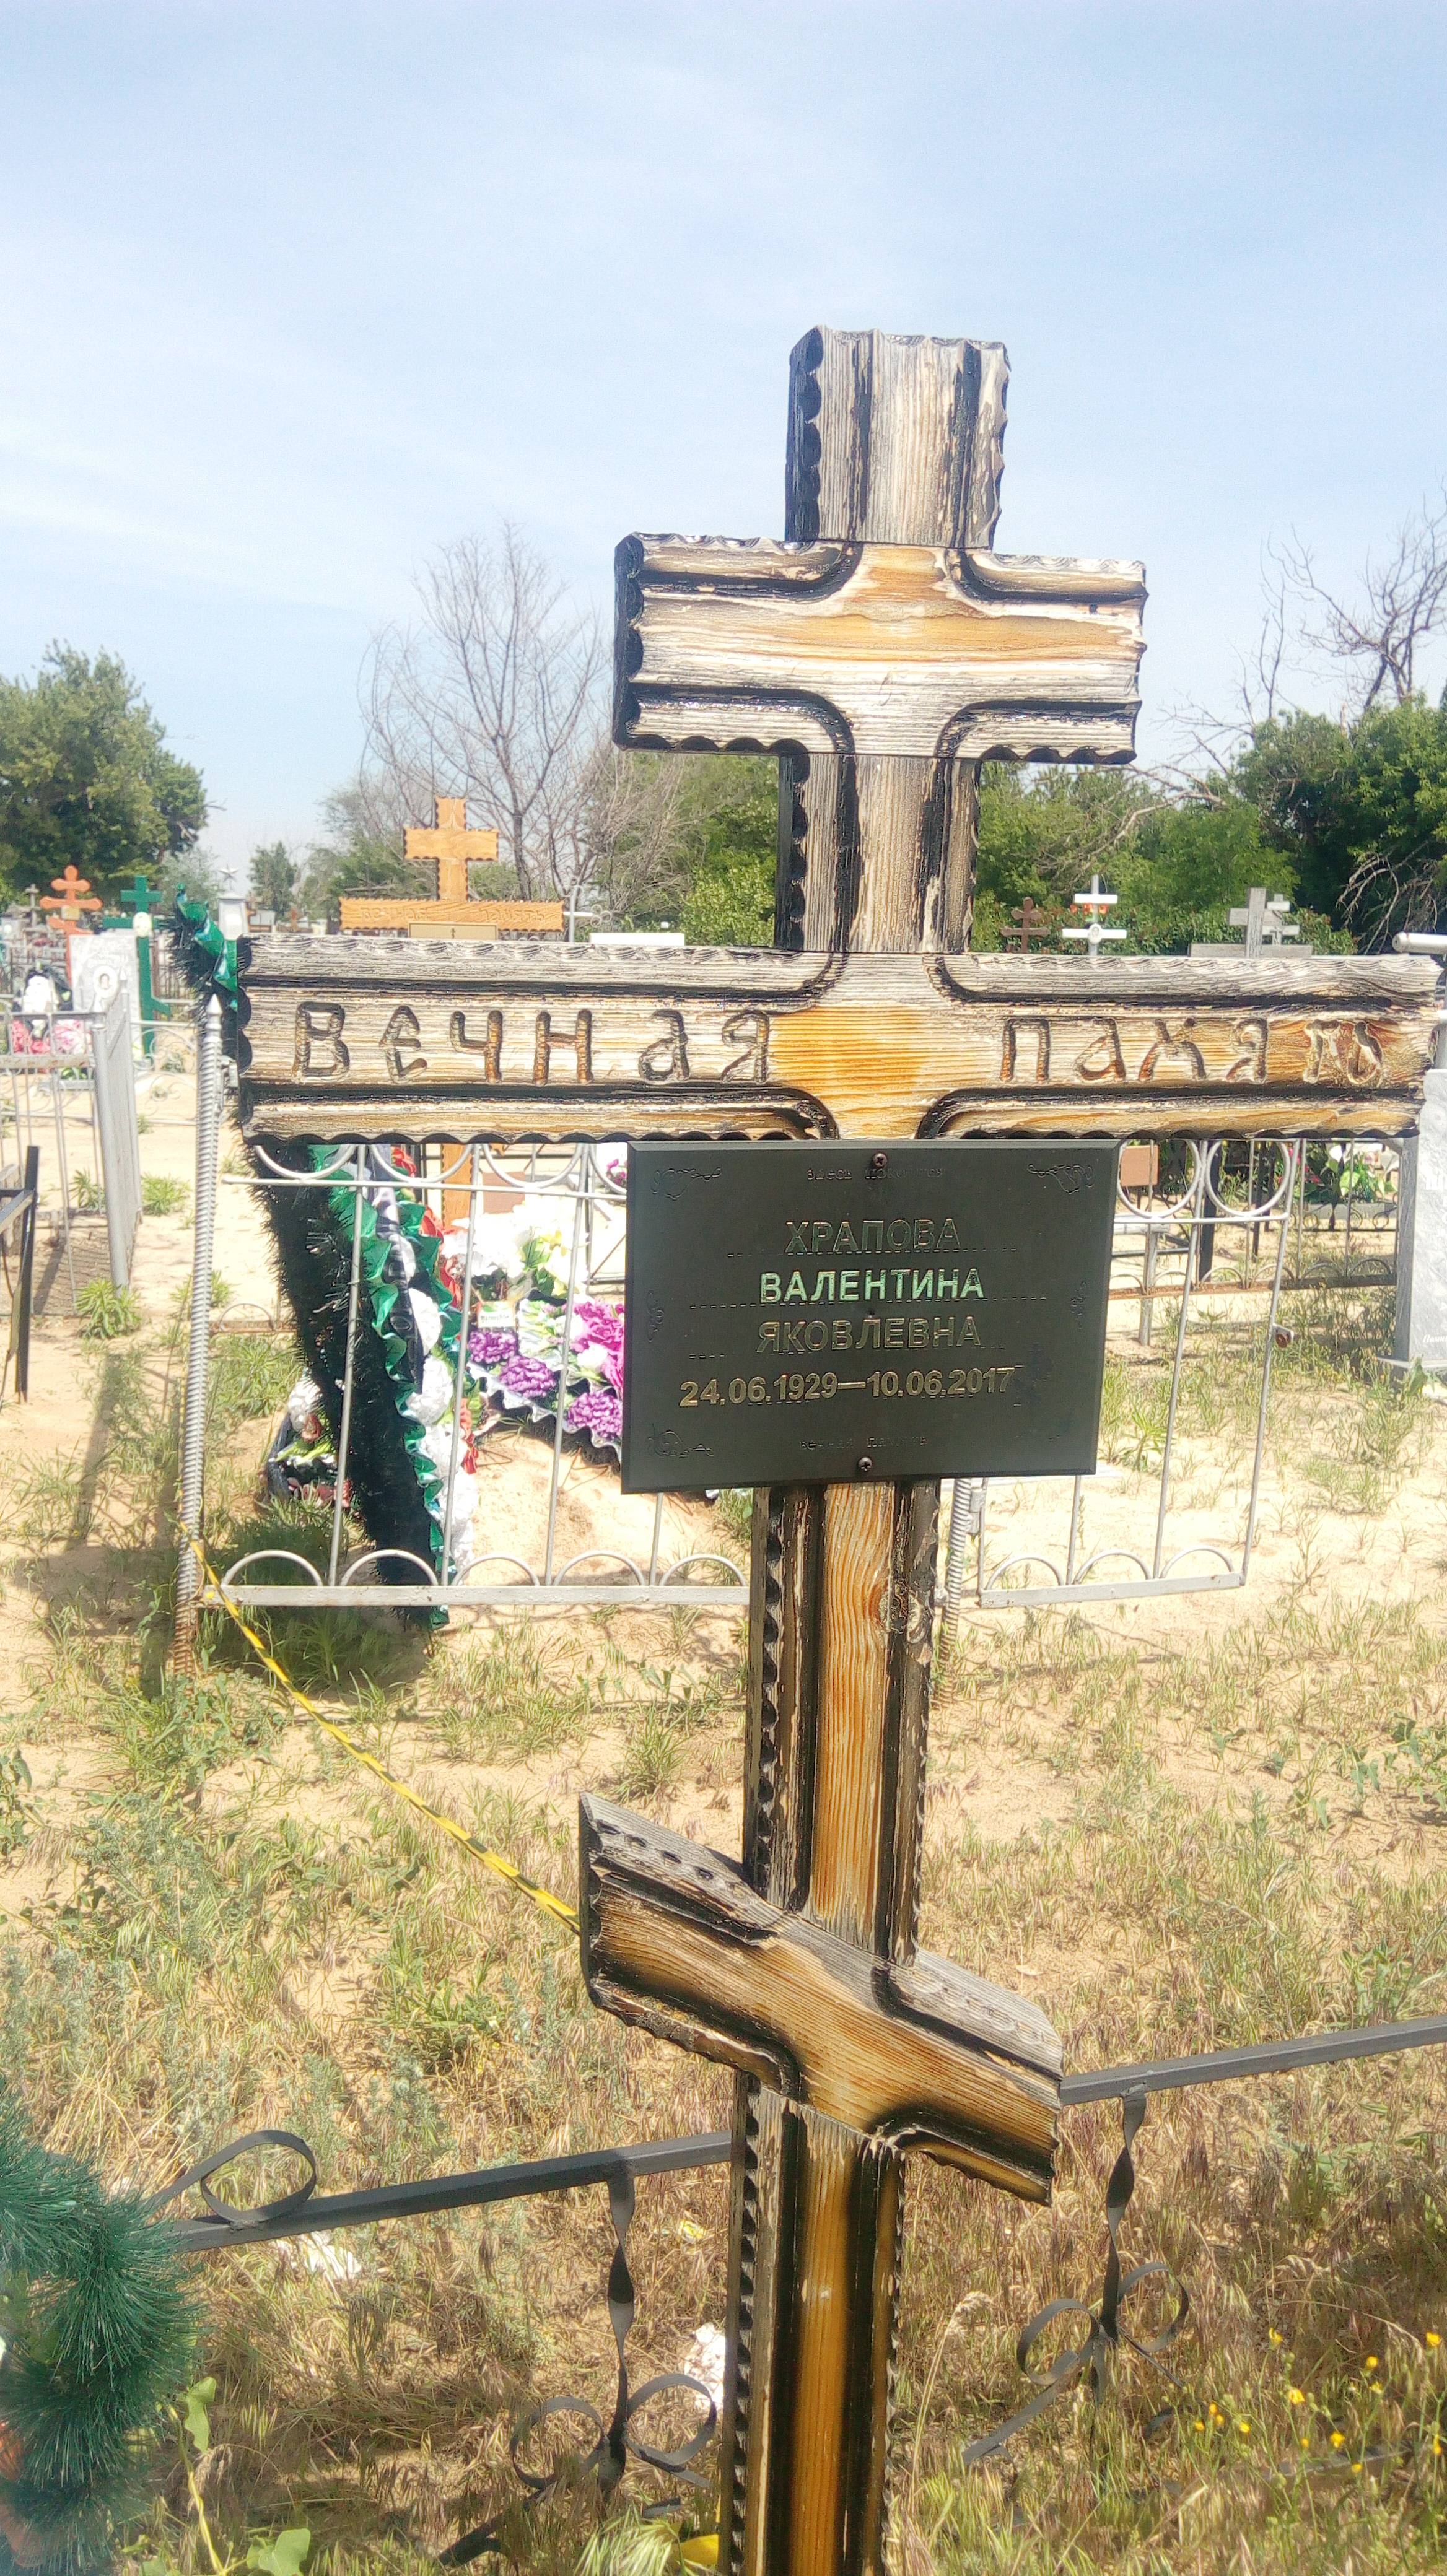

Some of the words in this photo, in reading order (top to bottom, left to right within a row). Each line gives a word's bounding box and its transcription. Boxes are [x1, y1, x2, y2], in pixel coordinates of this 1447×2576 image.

[785, 1217, 961, 1255] ХРАПОВА
[759, 1268, 986, 1305] ВАЛЕНТИНА
[757, 1315, 981, 1354] ЯКОВЛЕВНА
